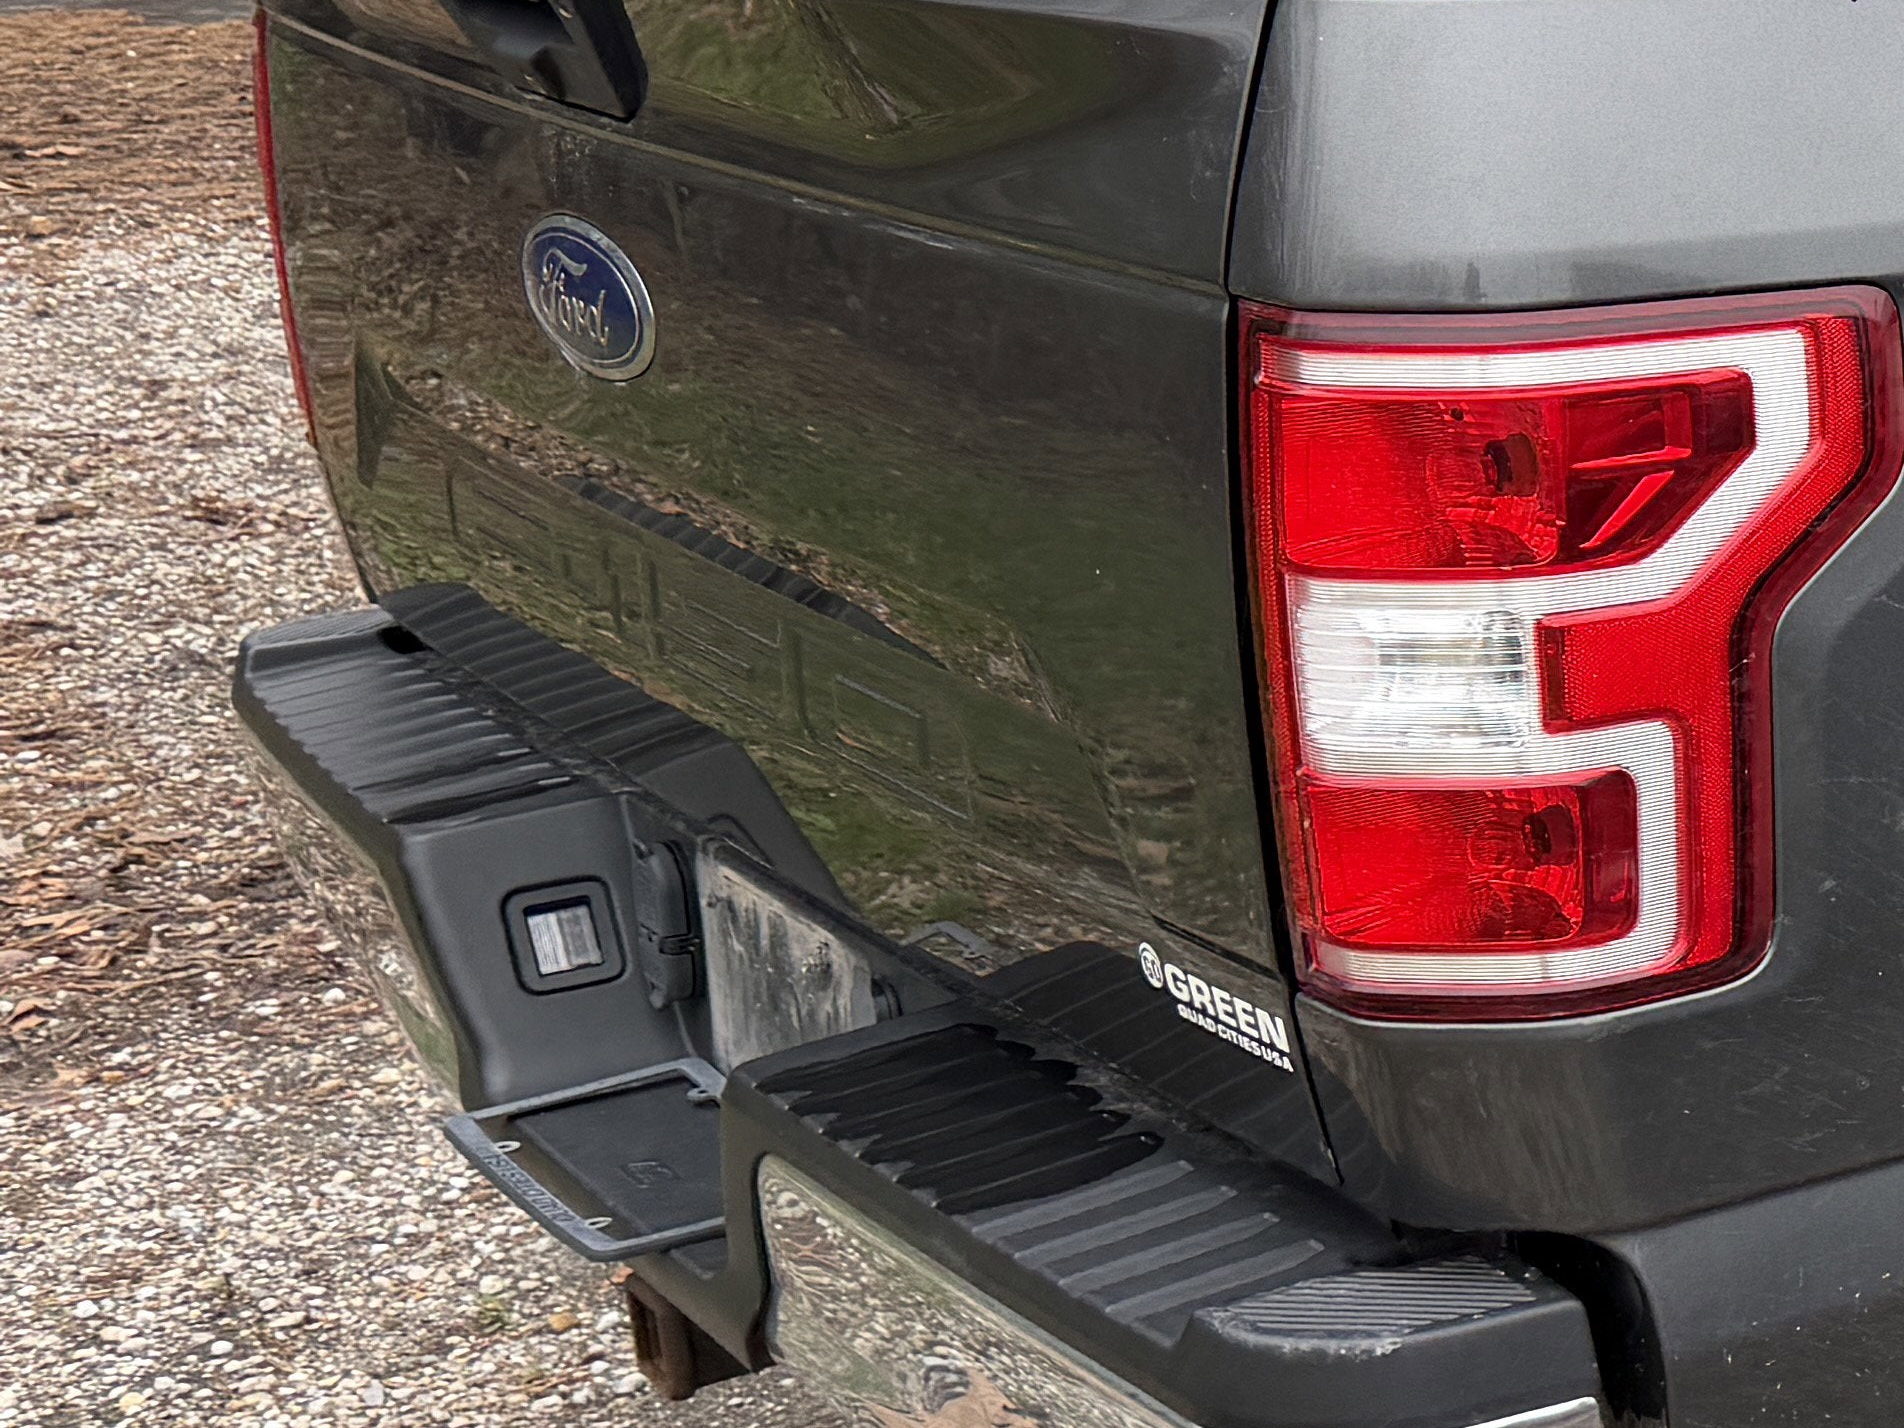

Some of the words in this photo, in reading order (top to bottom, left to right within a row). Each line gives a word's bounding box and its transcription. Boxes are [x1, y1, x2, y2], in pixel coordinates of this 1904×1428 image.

[1163, 963, 1291, 1054] GREEN
[1176, 1003, 1217, 1033] QUAD
[1218, 1023, 1262, 1057] CITIES
